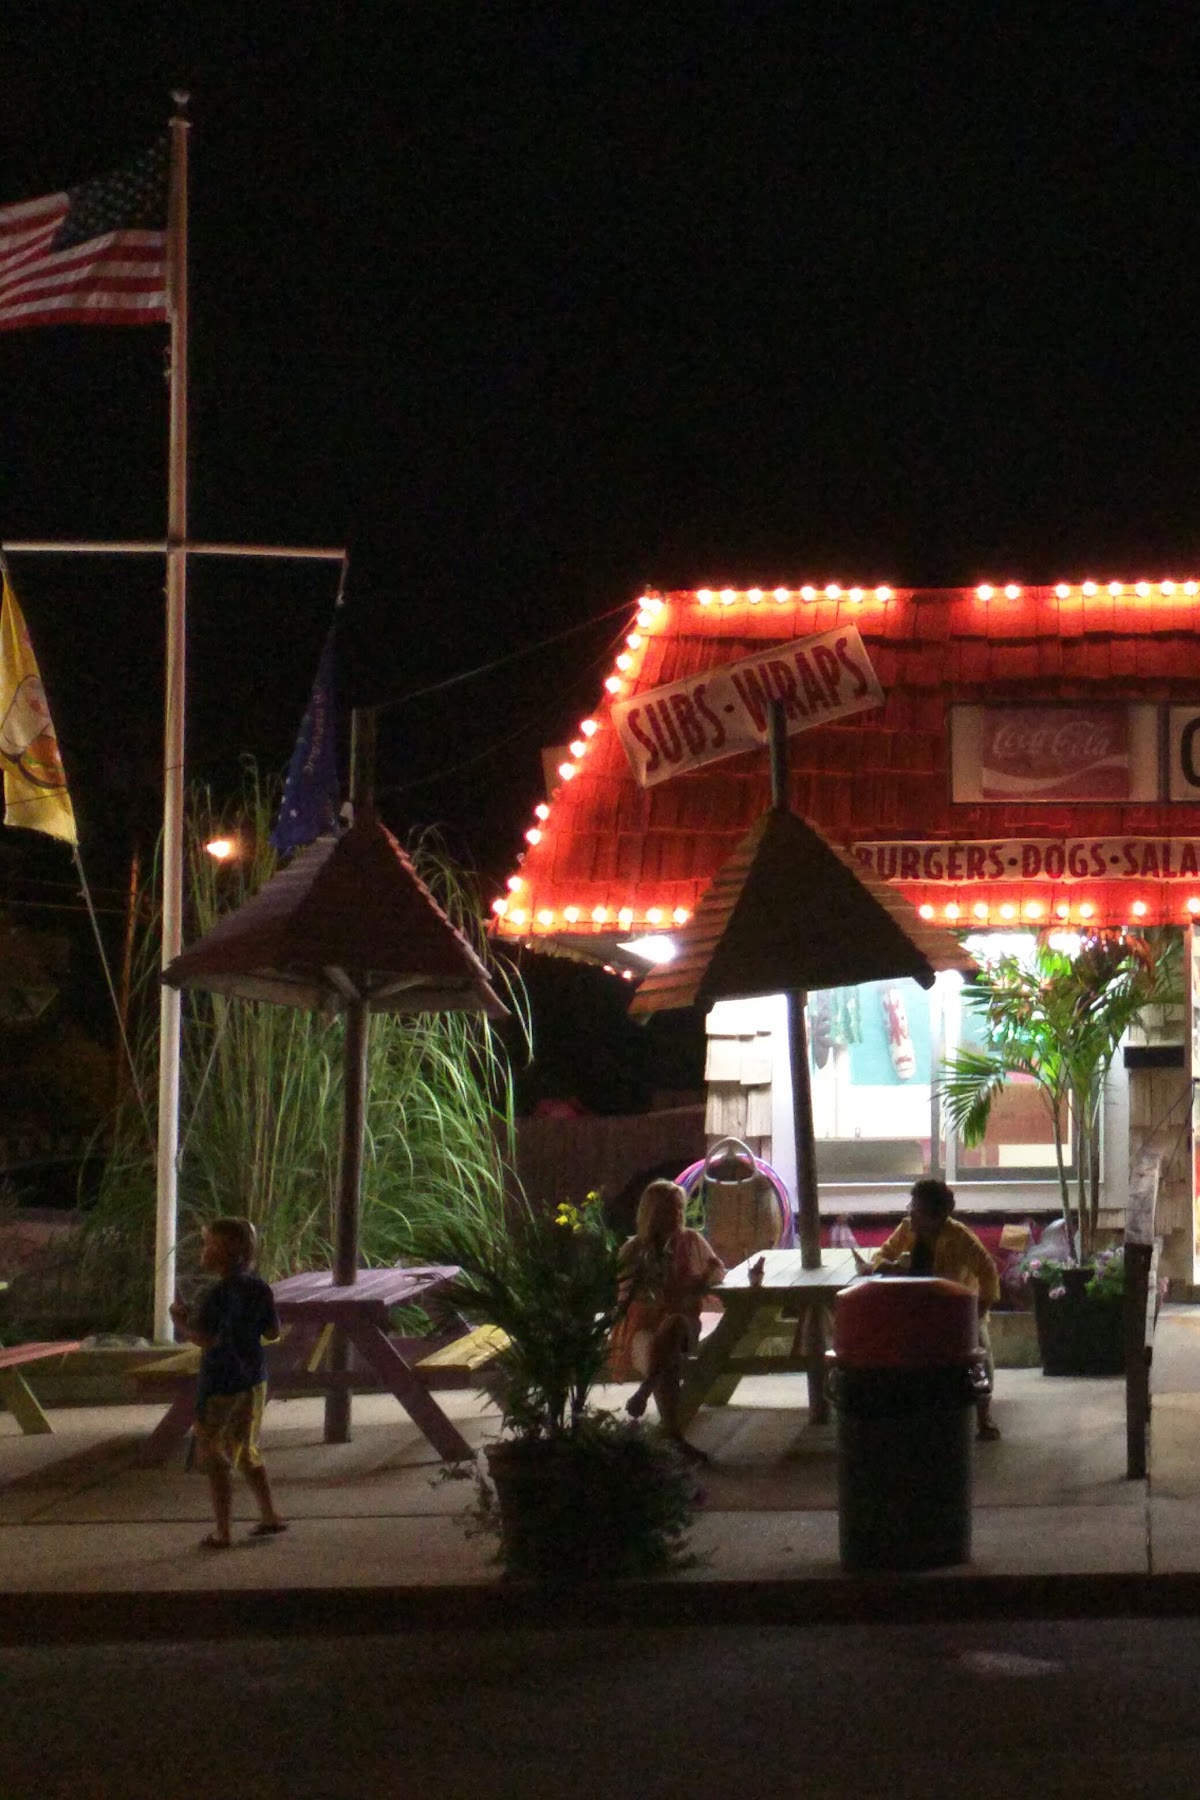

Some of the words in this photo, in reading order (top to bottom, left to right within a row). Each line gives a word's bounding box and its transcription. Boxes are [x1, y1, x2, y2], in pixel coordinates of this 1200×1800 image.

[627, 684, 725, 772] SUBS
[731, 637, 868, 732] WRAPS
[1021, 841, 1106, 880] DOGS
